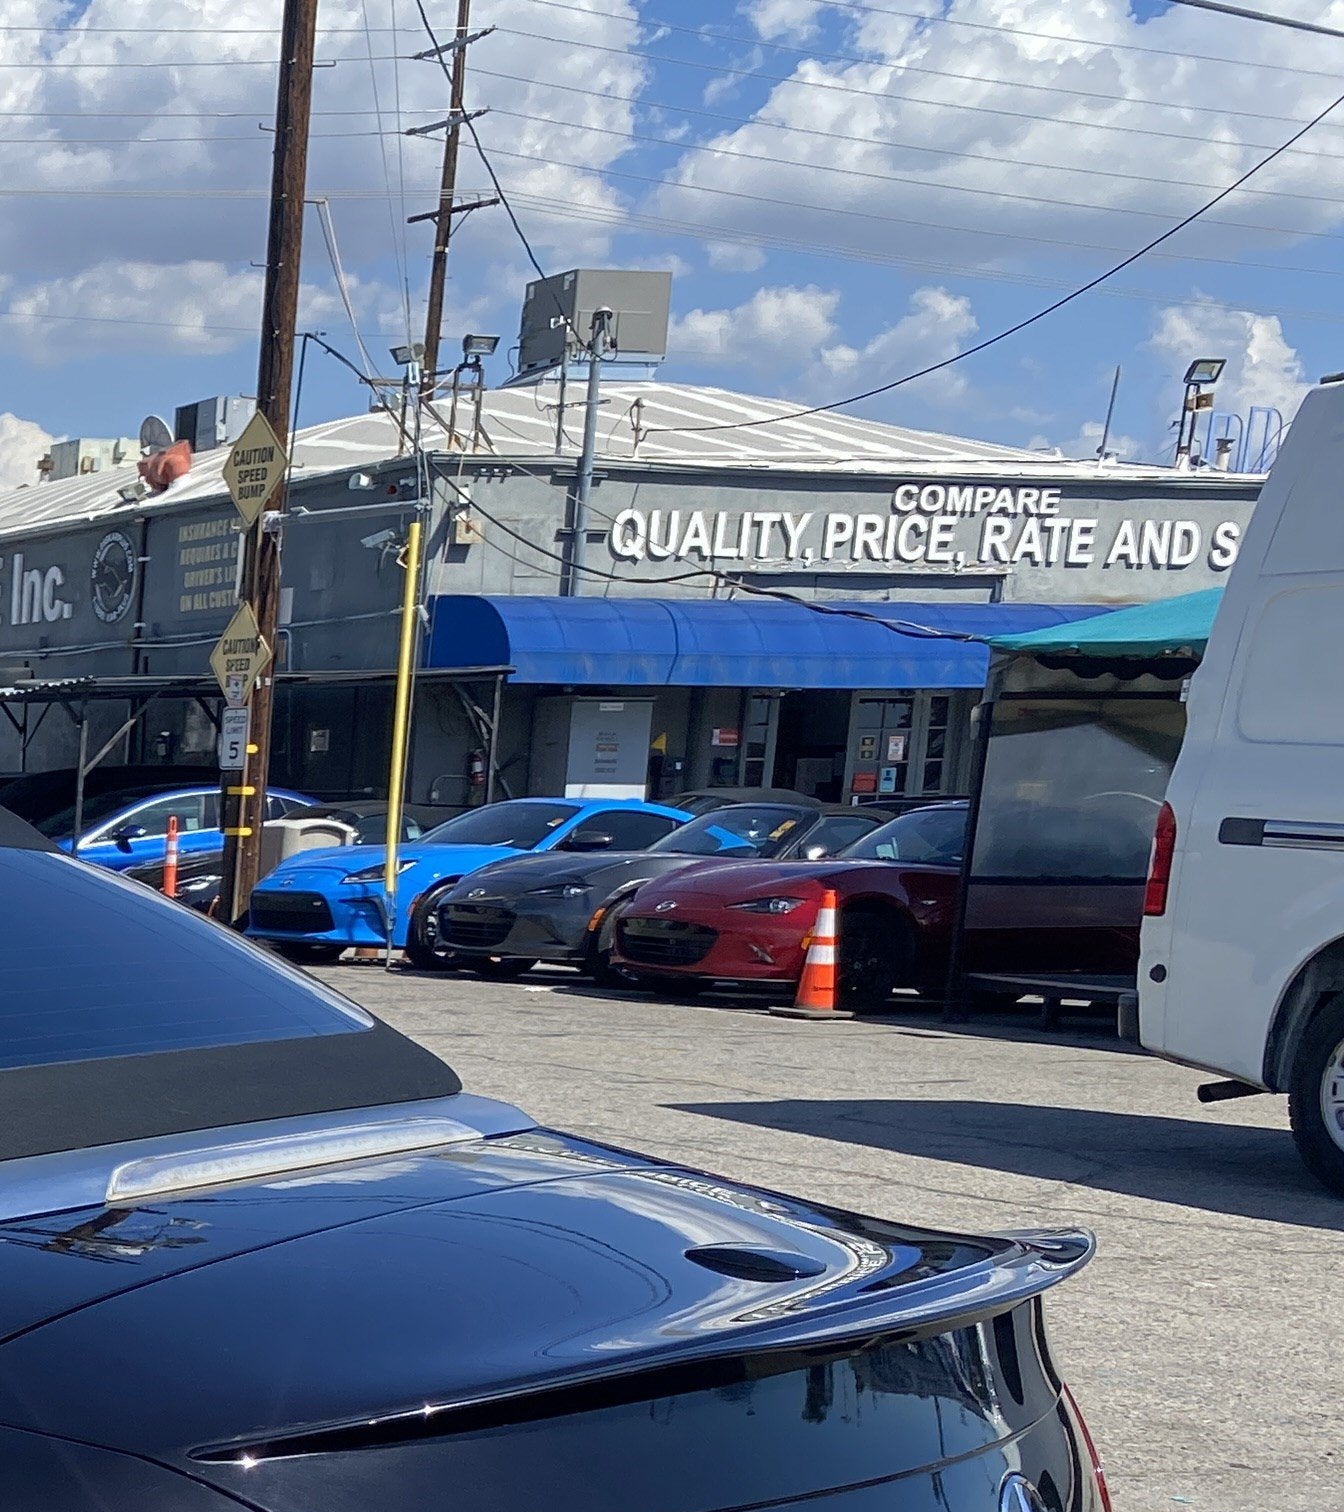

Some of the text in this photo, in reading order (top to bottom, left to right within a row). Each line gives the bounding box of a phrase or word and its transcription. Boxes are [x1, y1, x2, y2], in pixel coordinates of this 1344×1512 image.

[233, 446, 274, 467] CAUTION
[238, 468, 267, 483] SPEED
[238, 484, 265, 500] BUMP
[893, 483, 1061, 514] COMPARE
[612, 509, 814, 566] QUALITY,
[824, 513, 968, 569] PRICE,
[981, 516, 1097, 565] RATE
[1108, 520, 1200, 566] AND
[11, 553, 72, 626] Inc.
[223, 637, 257, 656] CAUTION
[226, 658, 250, 672] SPEED
[225, 715, 246, 725] SPEED
[229, 741, 239, 760] 5
